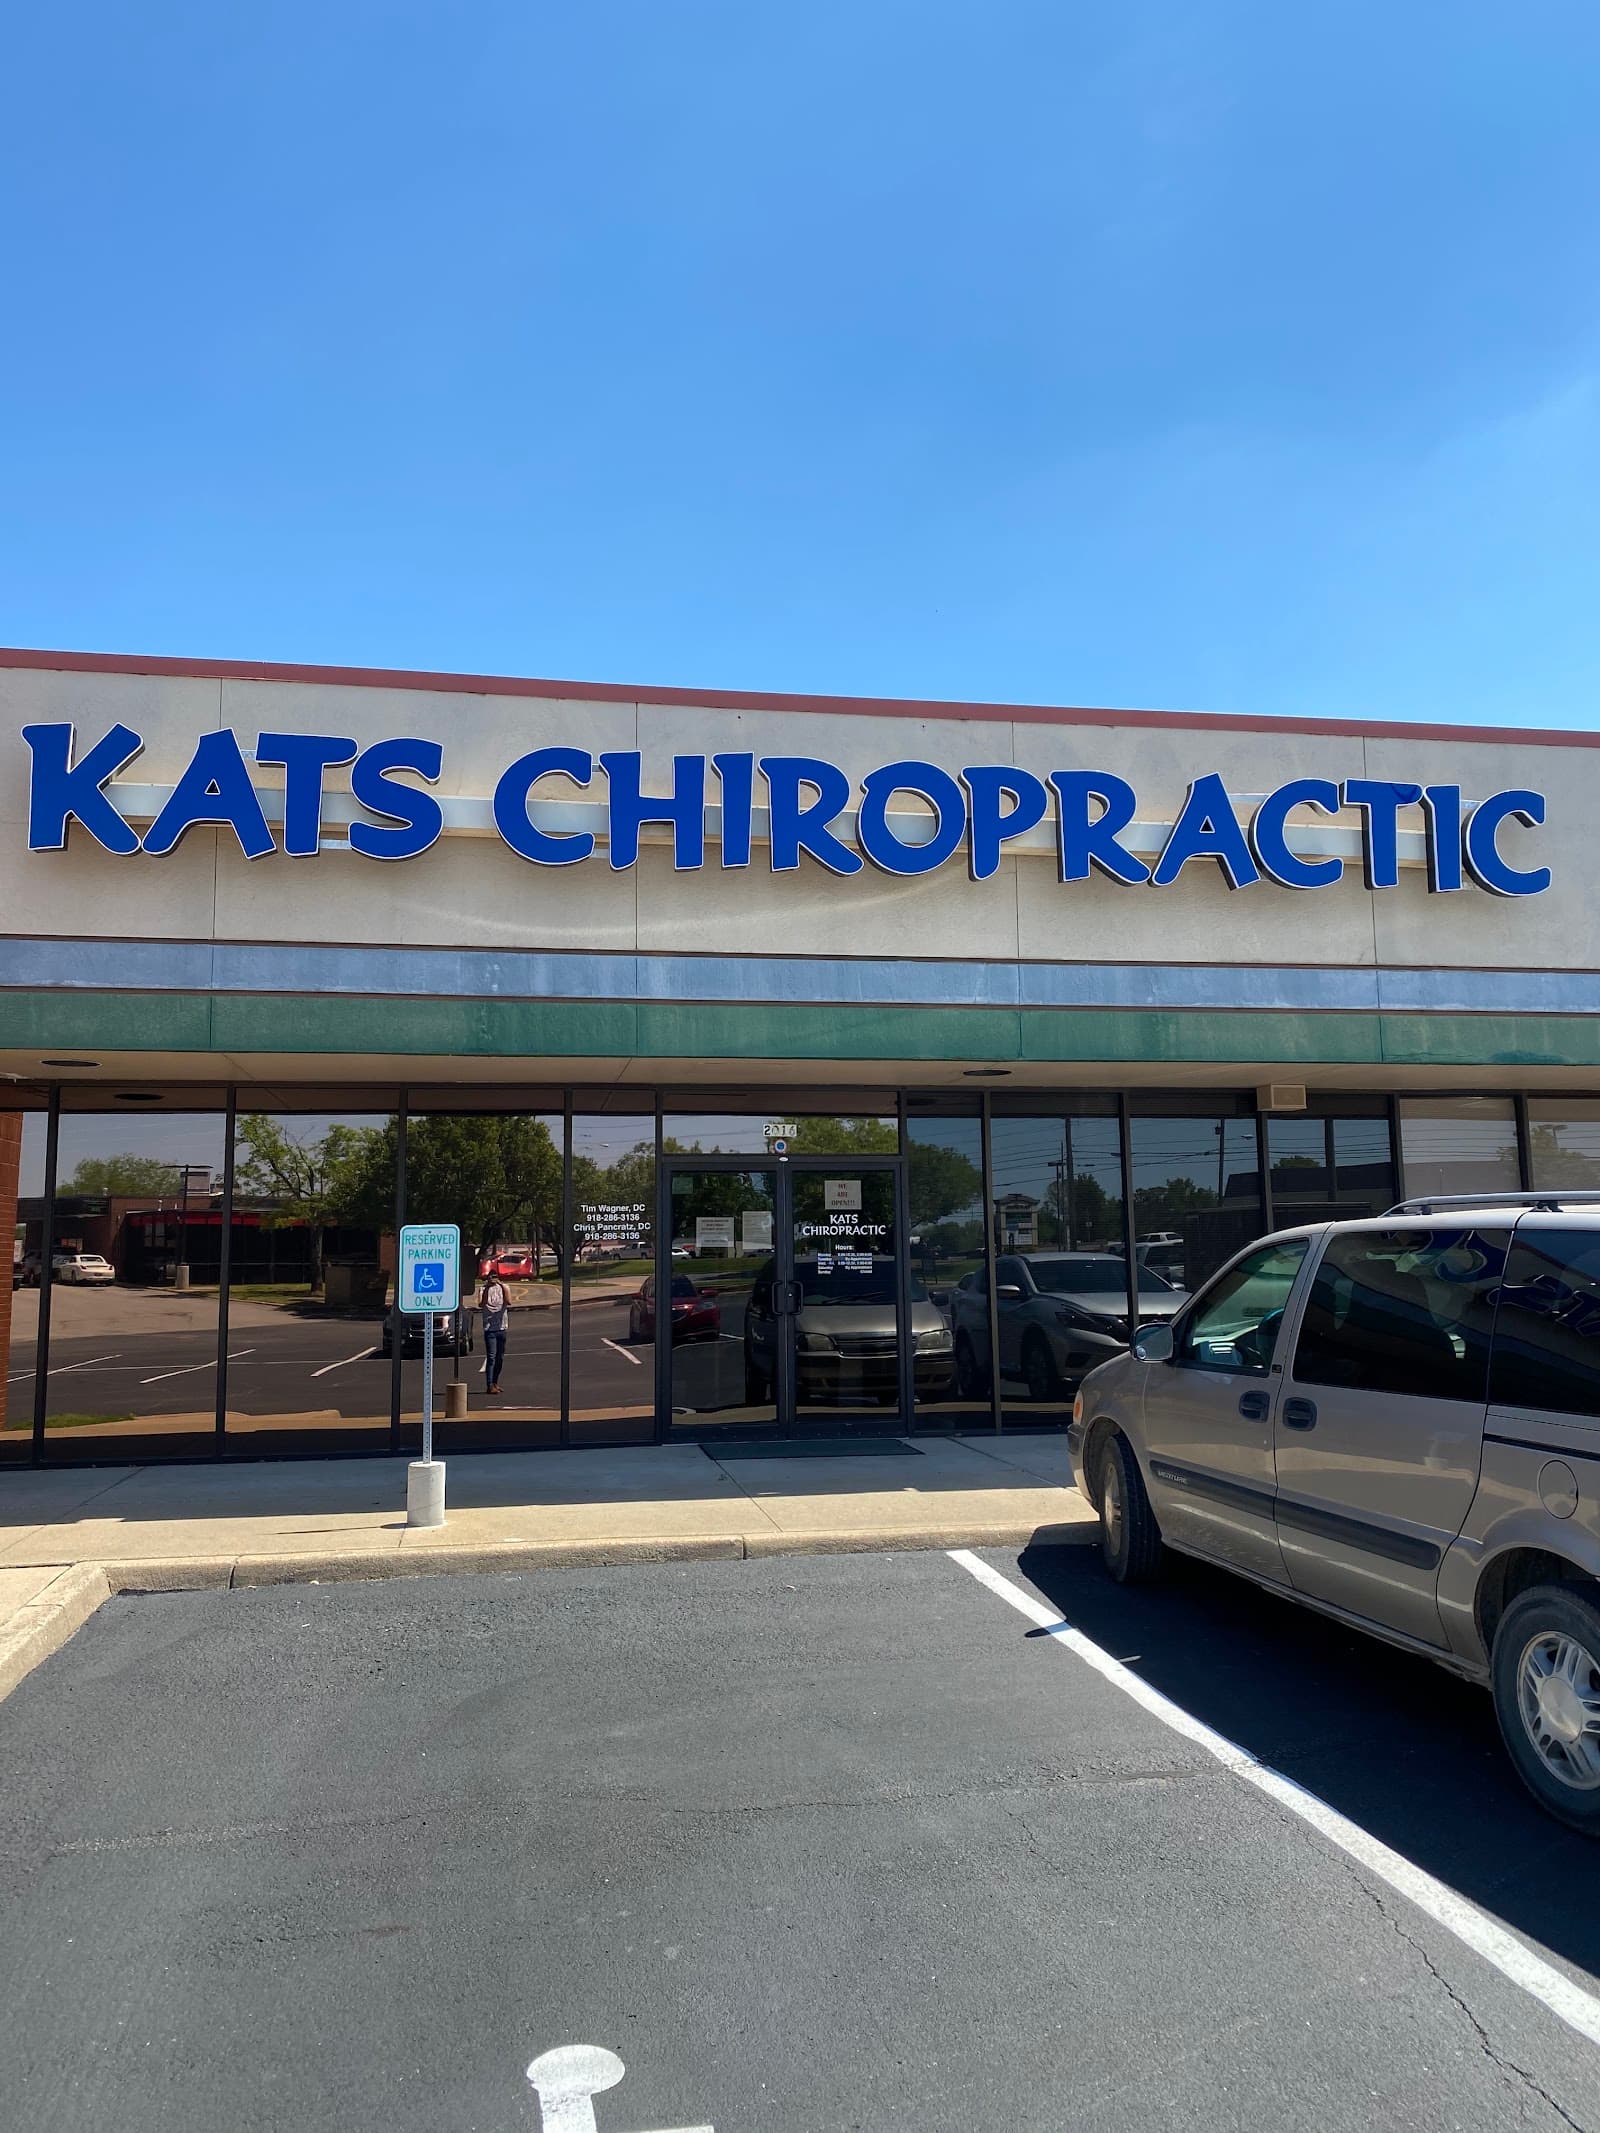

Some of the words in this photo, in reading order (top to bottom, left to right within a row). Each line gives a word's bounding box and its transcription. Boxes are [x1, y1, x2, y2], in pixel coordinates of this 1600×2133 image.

[20, 721, 444, 861] KATS
[492, 745, 1552, 897] CHIROPRACTIC
[764, 1125, 796, 1136] 2016
[581, 1204, 596, 1212] Tim
[598, 1204, 631, 1213] Wagner,
[633, 1203, 646, 1212] DC
[586, 1213, 640, 1222] 918-286-3136
[829, 1214, 859, 1225] KATS
[573, 1223, 595, 1232] Chris
[597, 1223, 636, 1231] Pancratz,
[638, 1222, 651, 1230] DC
[802, 1224, 887, 1236] CHIROPRACTIC
[405, 1234, 455, 1245] RESERVED
[584, 1231, 640, 1241] 918-286-3136
[408, 1248, 452, 1259] PARKING
[415, 1296, 443, 1307] ONLY
